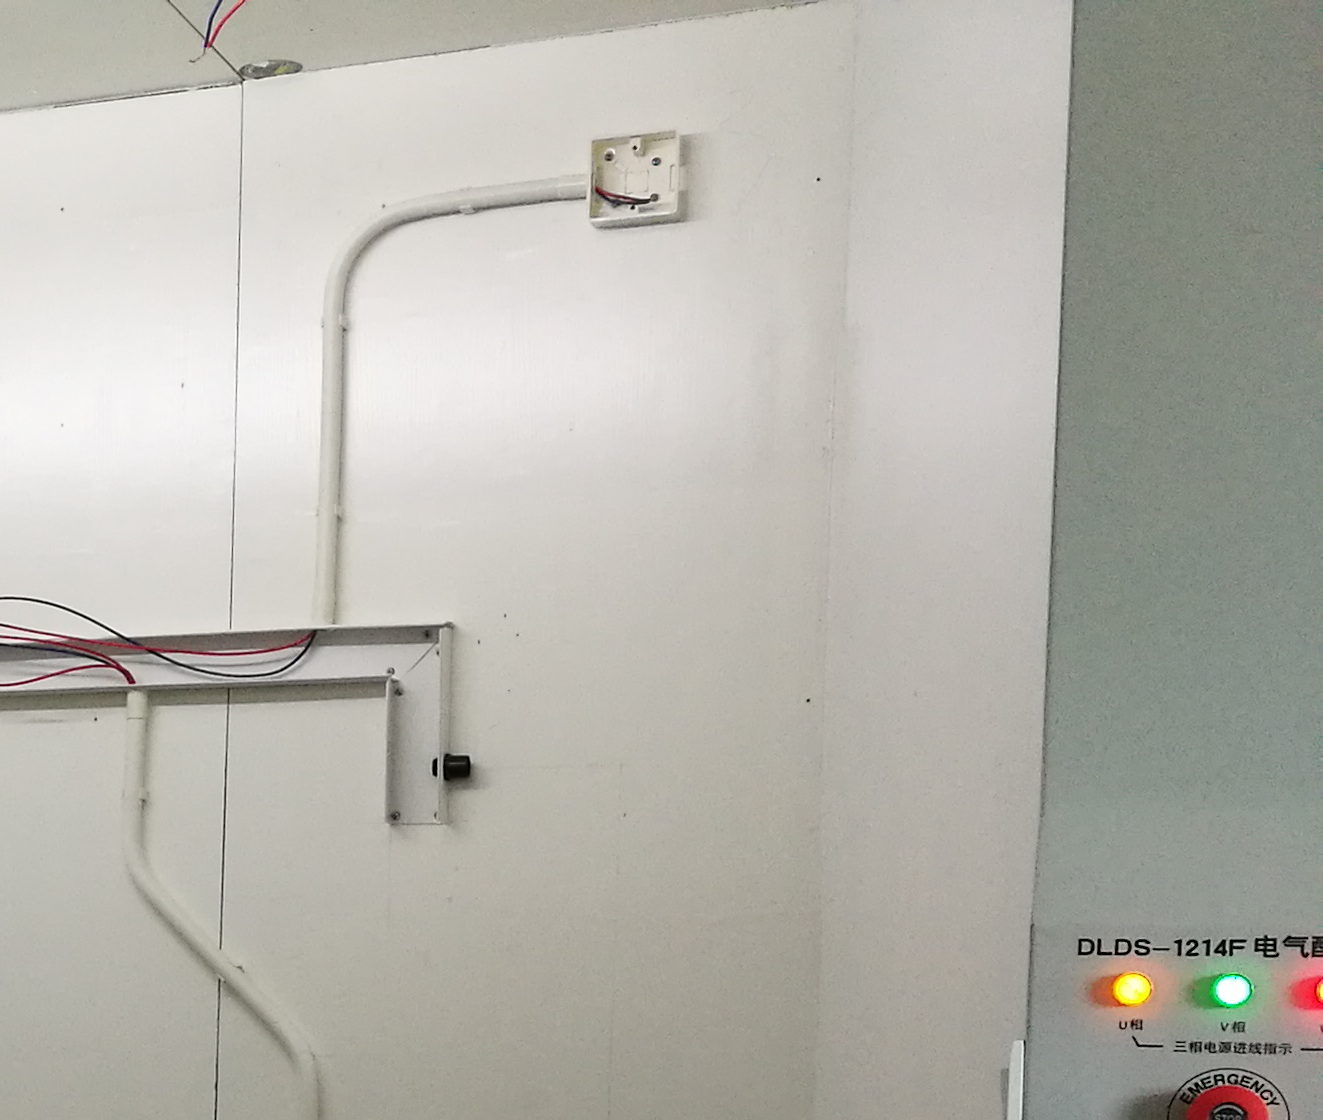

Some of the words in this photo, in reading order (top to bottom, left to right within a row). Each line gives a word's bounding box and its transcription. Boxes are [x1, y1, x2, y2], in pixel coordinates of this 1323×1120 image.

[1173, 1040, 1293, 1056] 三相电源进线指示
[1179, 1073, 1280, 1107] EMERGENCY
